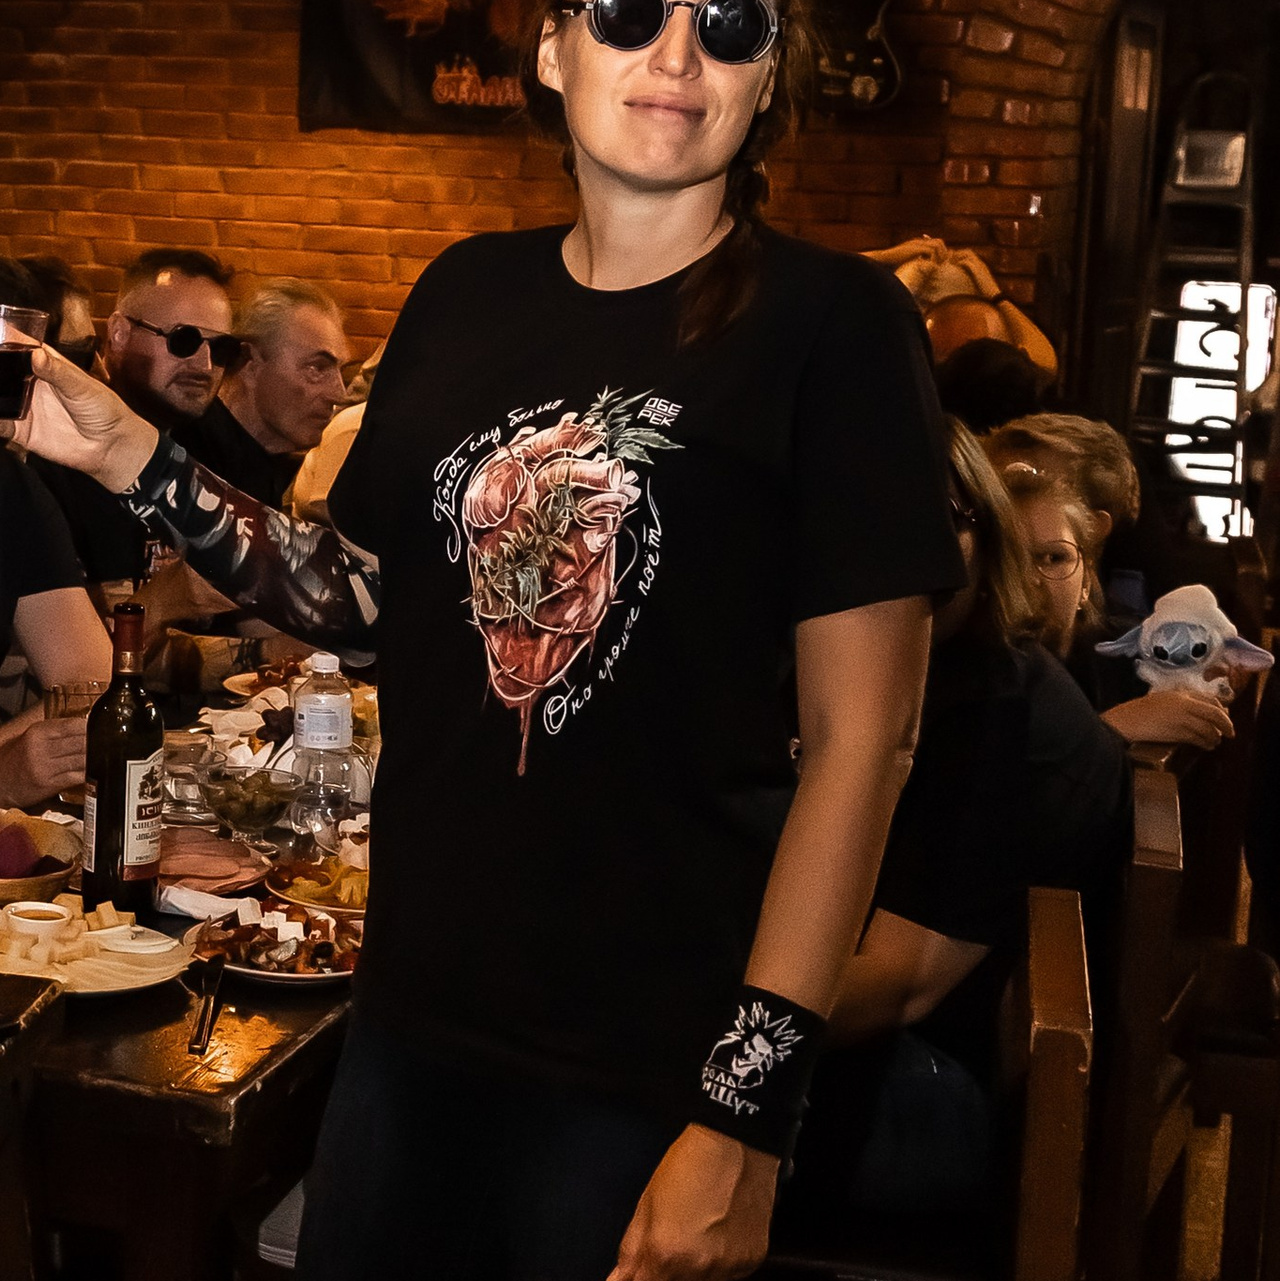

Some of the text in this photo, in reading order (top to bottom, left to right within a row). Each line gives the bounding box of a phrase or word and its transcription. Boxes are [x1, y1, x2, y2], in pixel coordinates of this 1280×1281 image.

[637, 409, 675, 427] РЕК
[644, 397, 683, 416] ОБЕ
[433, 398, 565, 563] Когда ему больно
[543, 684, 592, 734] Оно
[599, 606, 640, 682] громче
